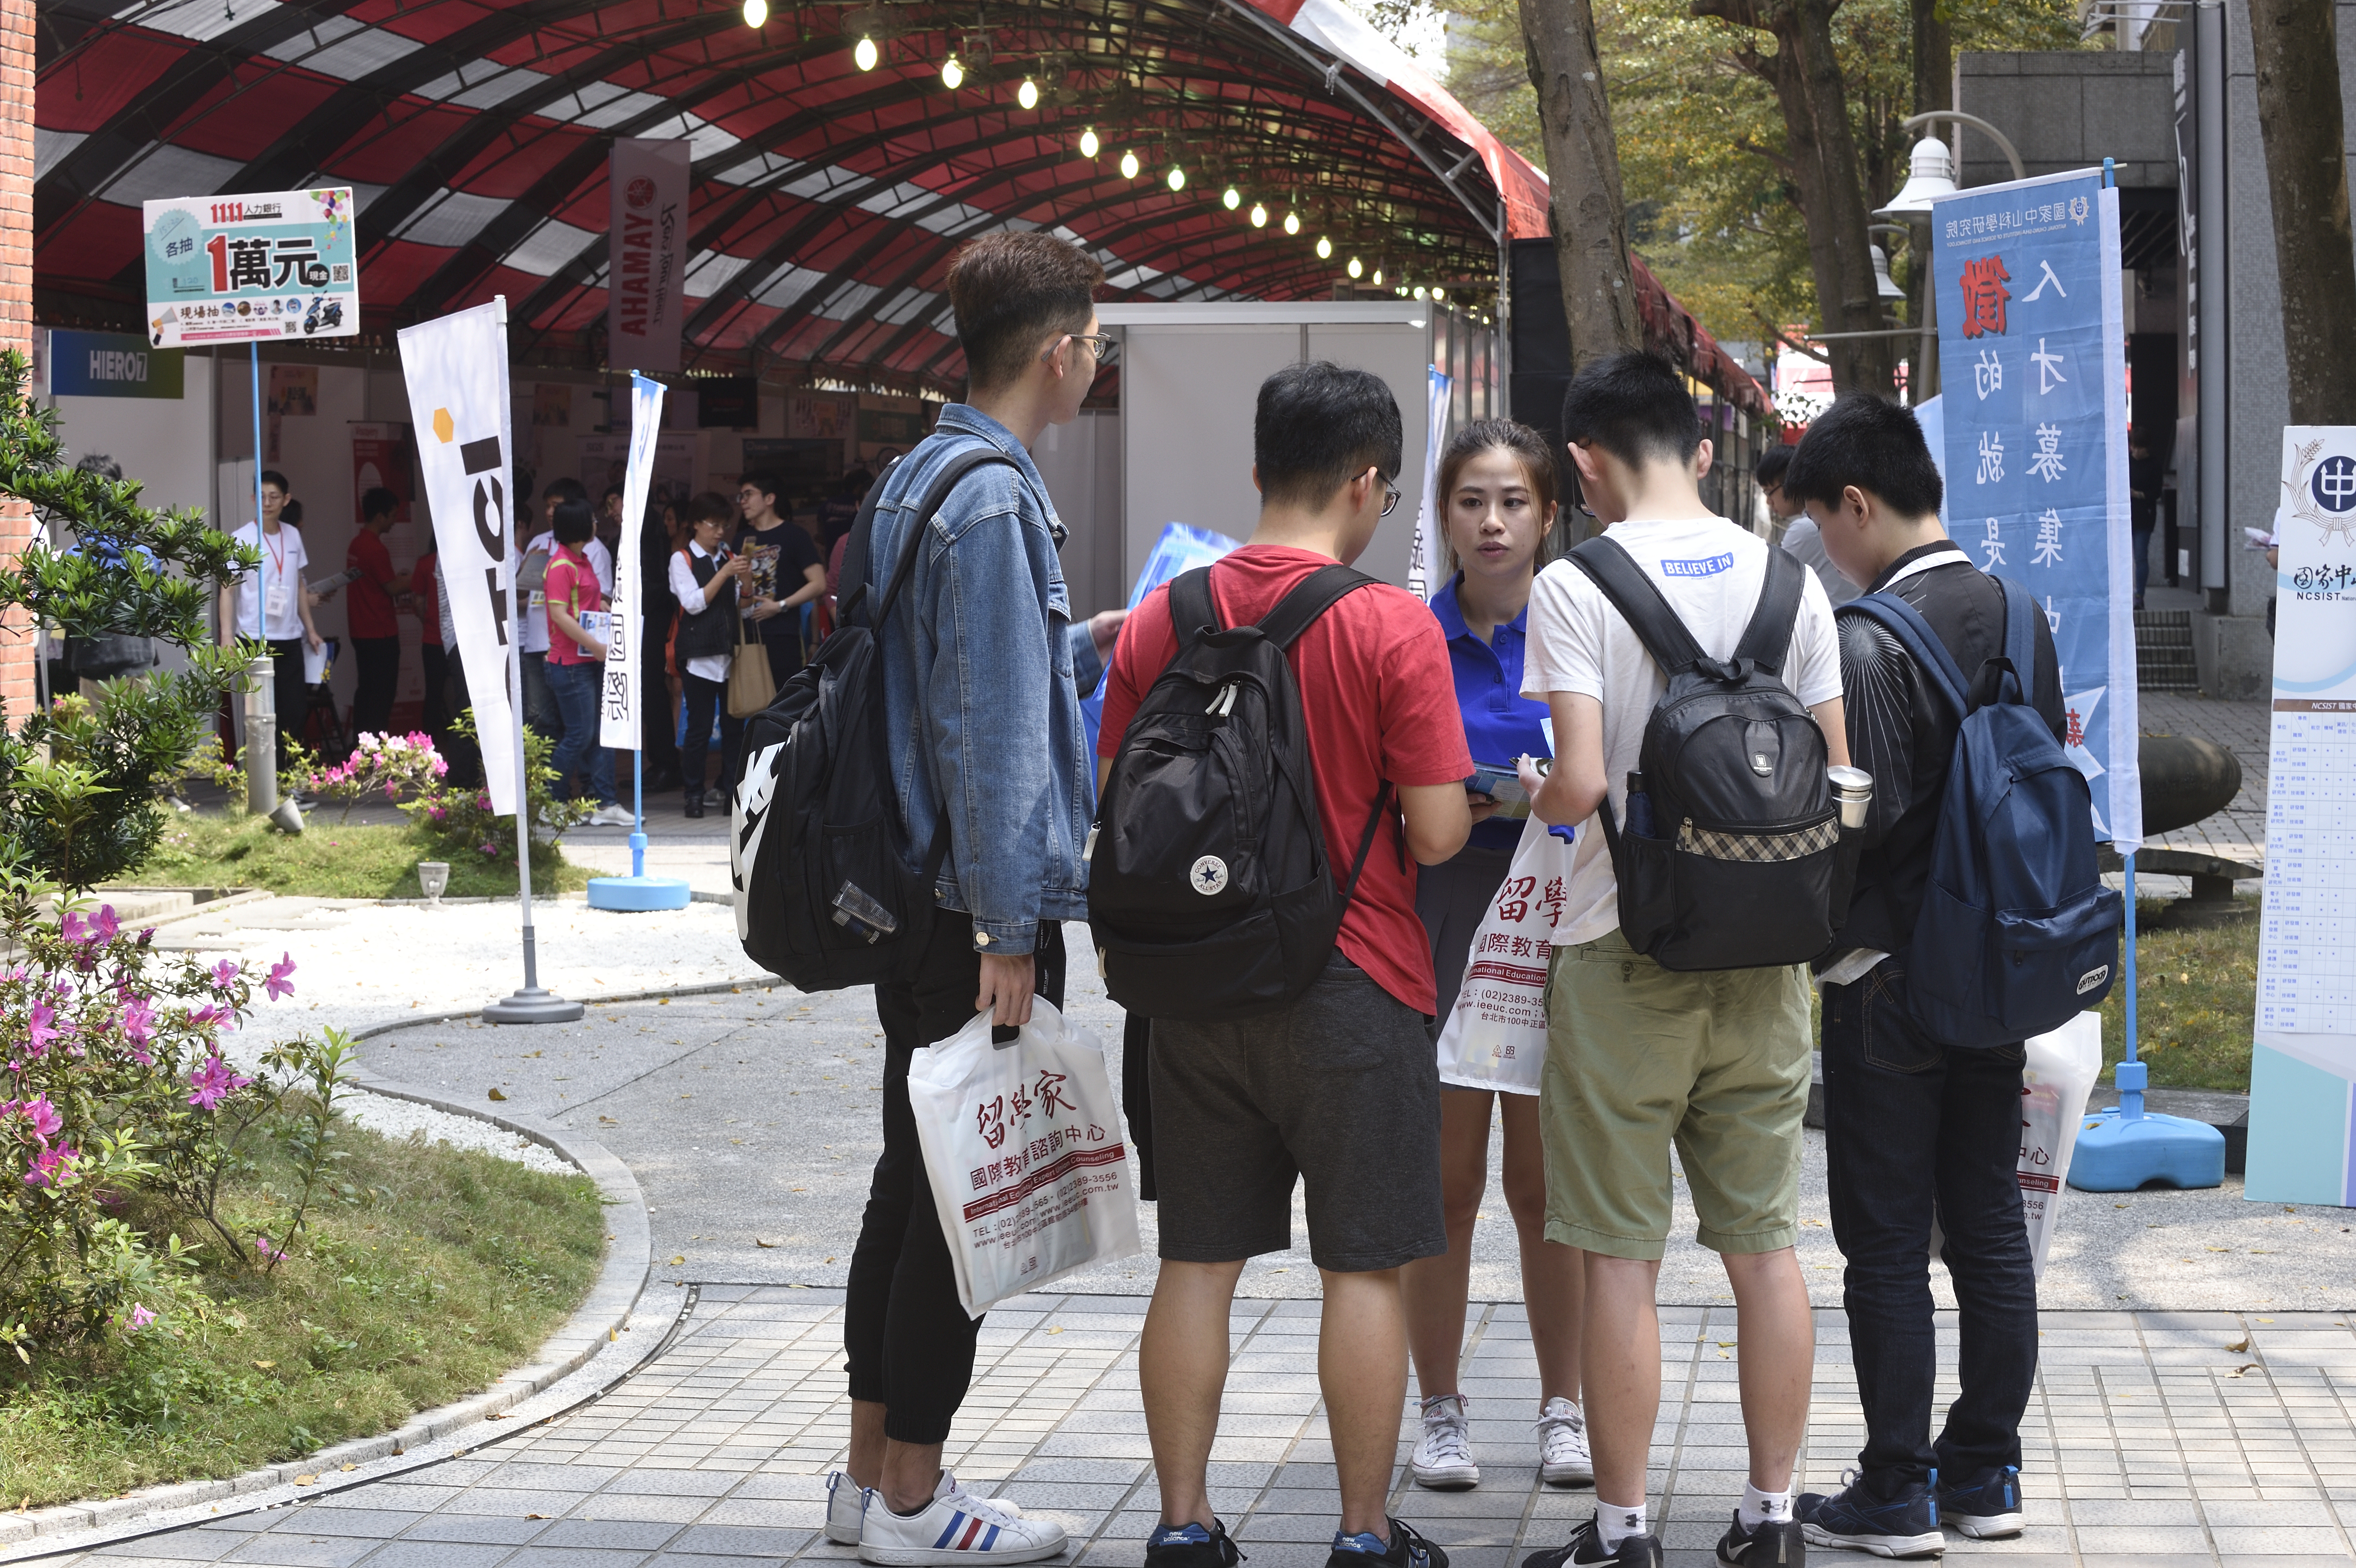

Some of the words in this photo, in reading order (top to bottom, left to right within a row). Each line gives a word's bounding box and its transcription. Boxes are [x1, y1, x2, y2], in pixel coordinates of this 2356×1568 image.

[245, 203, 282, 214] 人力銀行
[166, 237, 193, 258] 各抽
[207, 235, 318, 291] 1萬元
[309, 270, 328, 282] 現金
[181, 305, 219, 319] 現場抽
[89, 350, 147, 381] HIERO7
[1665, 560, 1715, 574] BELIEVE
[1717, 555, 1731, 569] IN
[2297, 592, 2341, 601] NCSIST
[1195, 860, 1222, 873] CONVERSE
[1210, 881, 1222, 891] STAR
[1506, 969, 1546, 981] Education
[971, 1194, 1008, 1215] Internatinal
[1033, 1171, 1056, 1184] Expert
[1070, 1151, 1115, 1164] Counseling
[876, 1553, 915, 1563] adidas
